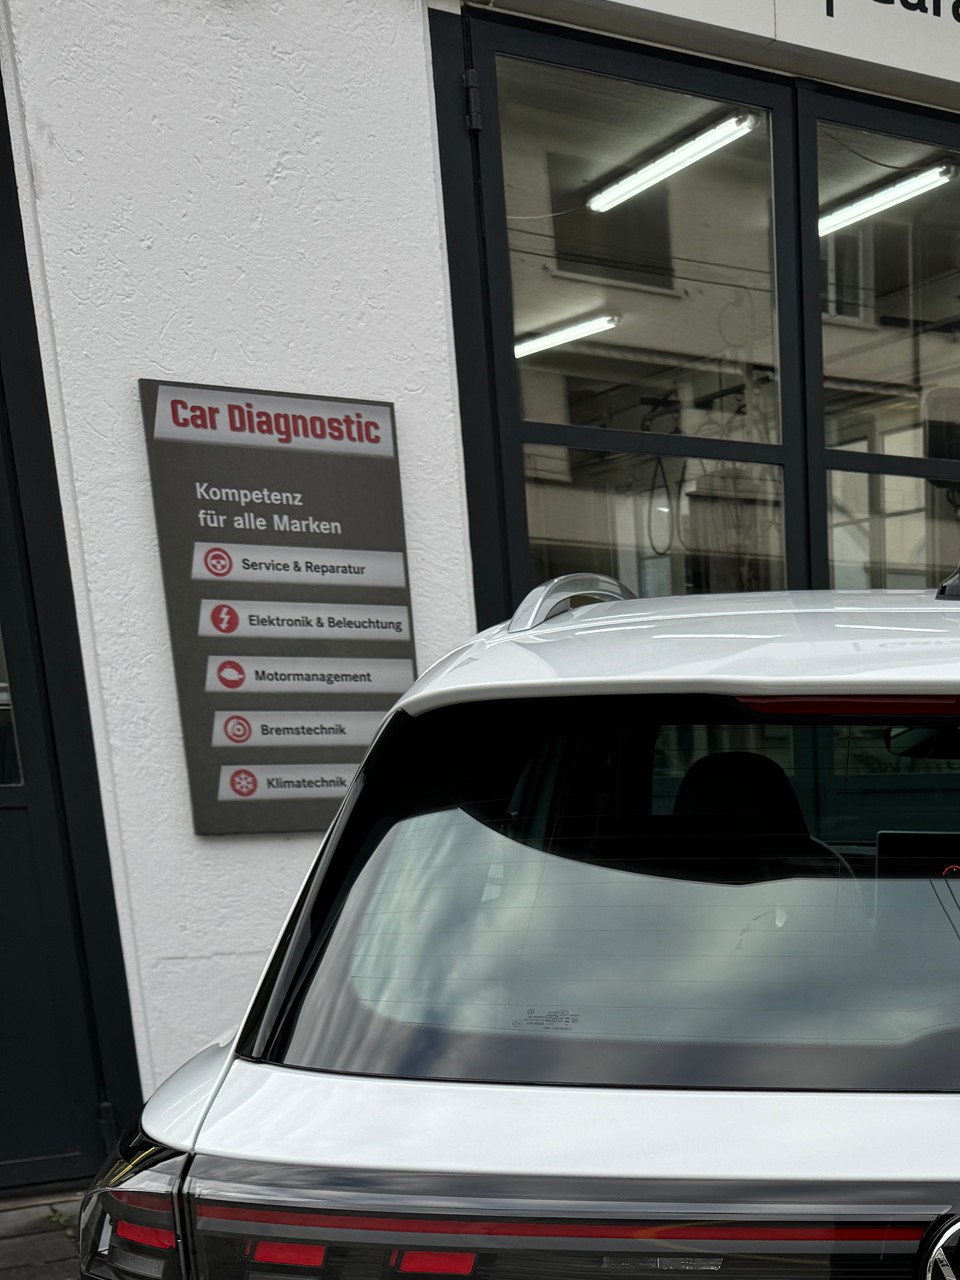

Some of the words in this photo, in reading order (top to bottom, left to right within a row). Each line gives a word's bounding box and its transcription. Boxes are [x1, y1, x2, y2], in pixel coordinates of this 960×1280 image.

[170, 399, 220, 430] Car
[227, 402, 381, 444] Diagnostic
[195, 482, 303, 506] Kompetenz
[198, 509, 227, 528] für
[233, 512, 267, 530] alle
[273, 514, 342, 535] Marken
[241, 558, 290, 572] Service
[293, 560, 302, 573] &
[305, 561, 366, 576] Reparatur
[248, 614, 313, 628] Elektronik
[316, 617, 324, 628] &
[328, 616, 403, 632] Beleuchtung
[254, 670, 372, 684] Motormanagement
[260, 723, 347, 737] Bremstechnik
[266, 776, 348, 789] Klimatechnik
